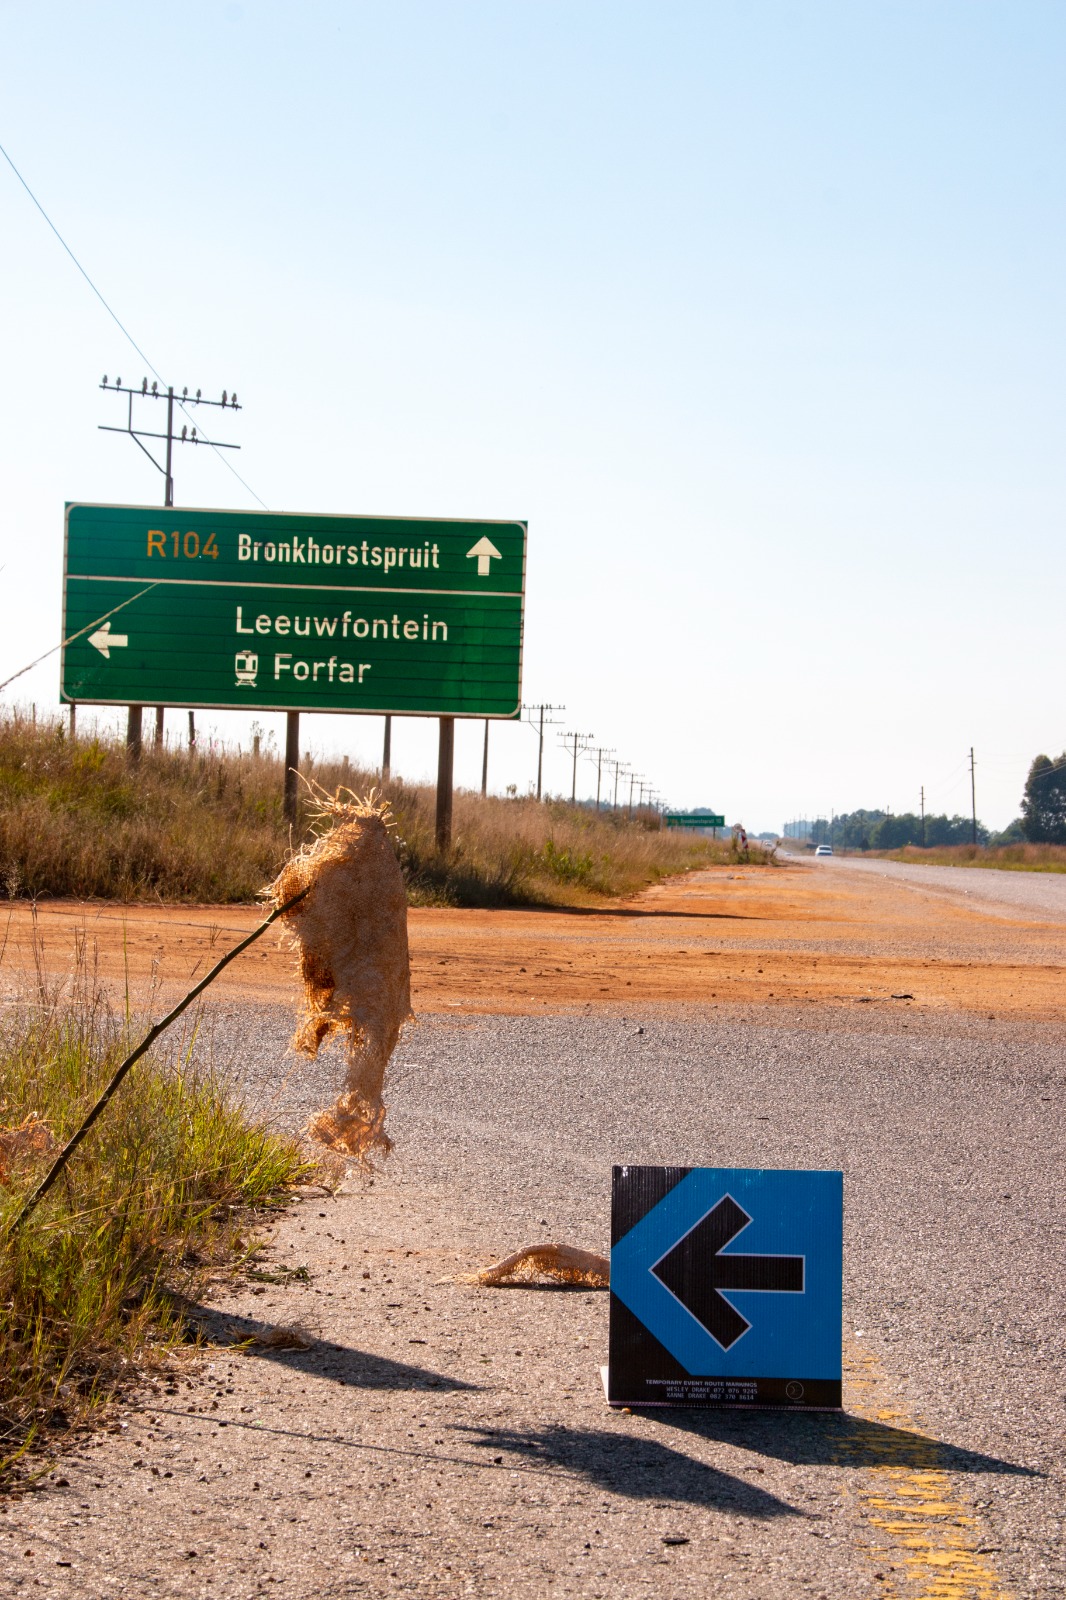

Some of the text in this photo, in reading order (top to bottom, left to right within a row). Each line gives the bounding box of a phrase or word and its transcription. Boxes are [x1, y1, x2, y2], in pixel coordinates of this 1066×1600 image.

[145, 529, 441, 574] R104 Bronkhorstspruit
[235, 606, 449, 642] Leeuwfontein
[273, 653, 372, 684] Forfar
